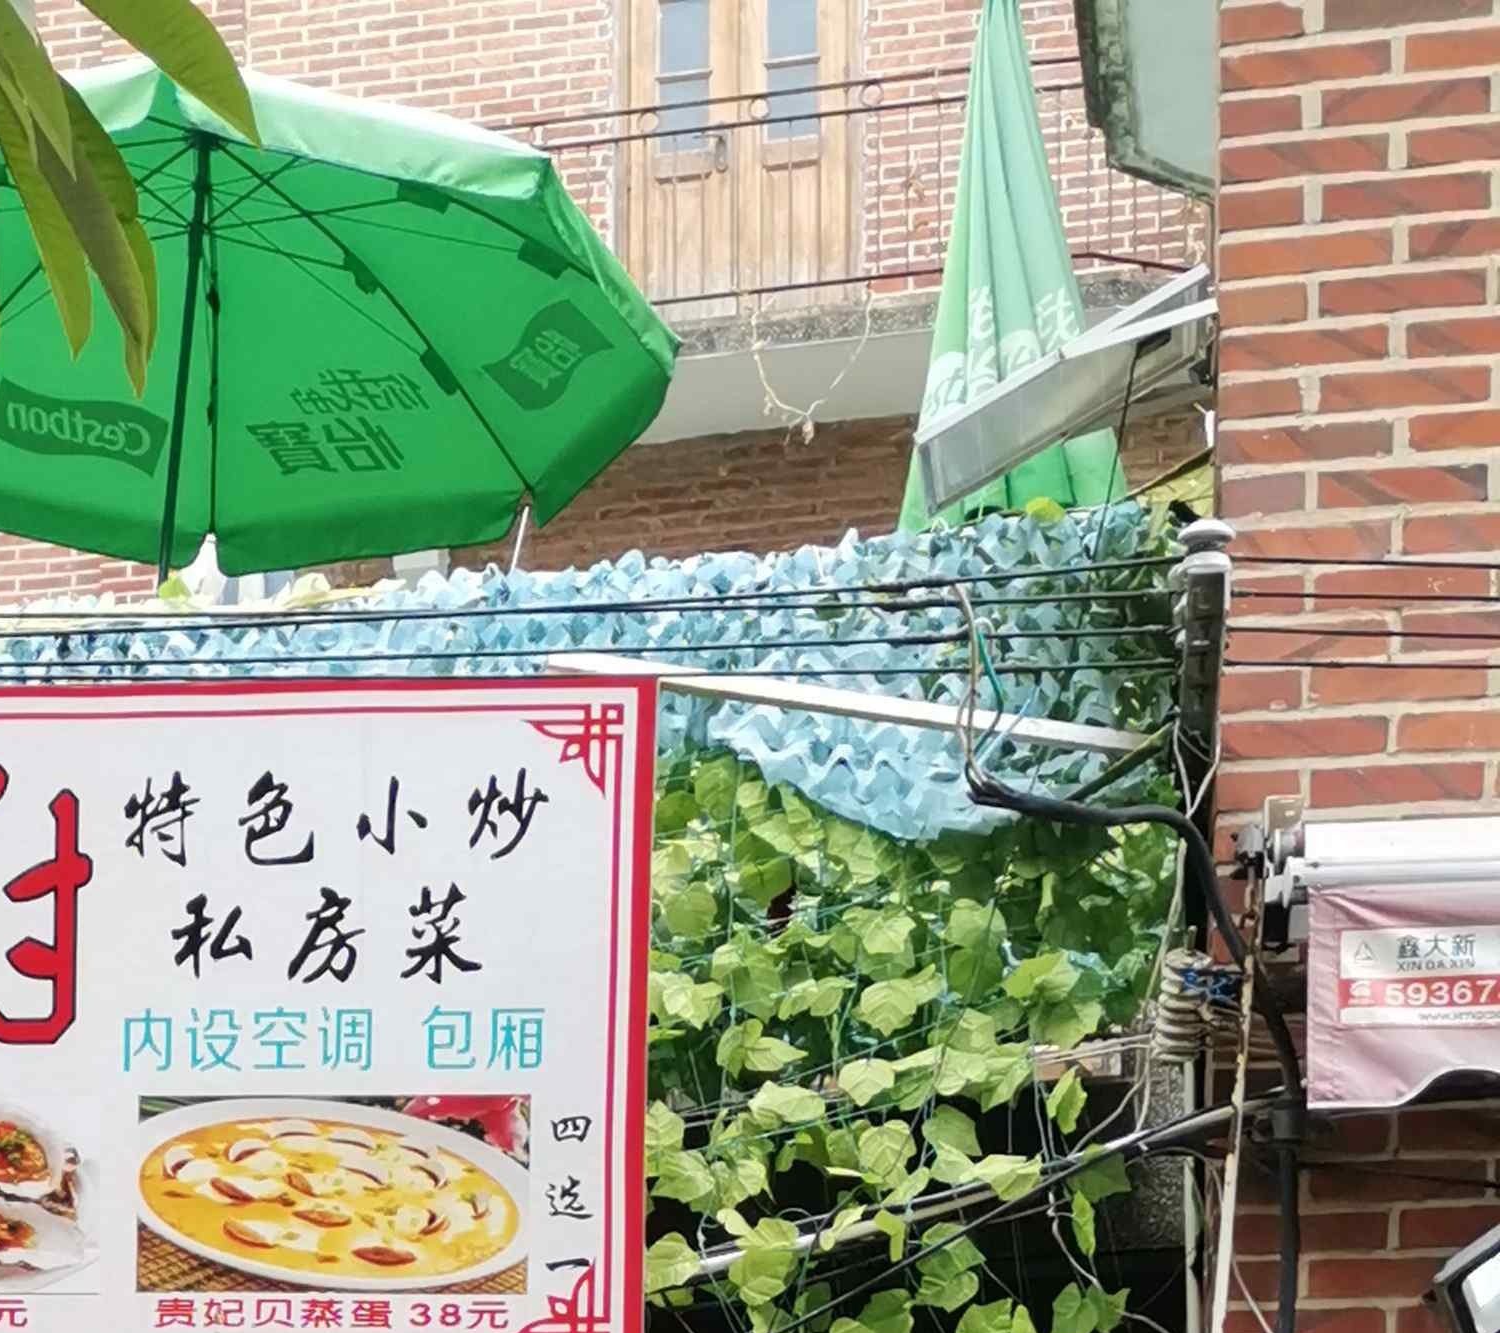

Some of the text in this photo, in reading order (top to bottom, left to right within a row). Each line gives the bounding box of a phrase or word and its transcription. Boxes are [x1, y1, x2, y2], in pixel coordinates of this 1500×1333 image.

[124, 767, 550, 867] 特色小炒
[171, 881, 483, 984] 私房菜
[1396, 933, 1477, 959] 鑫大新
[1384, 979, 1500, 1006] 59367
[122, 1005, 546, 1072] 内设空调 包厢
[545, 1115, 594, 1273] 四选一
[153, 1297, 509, 1330] 贵妃贝蒸蛋 38元
